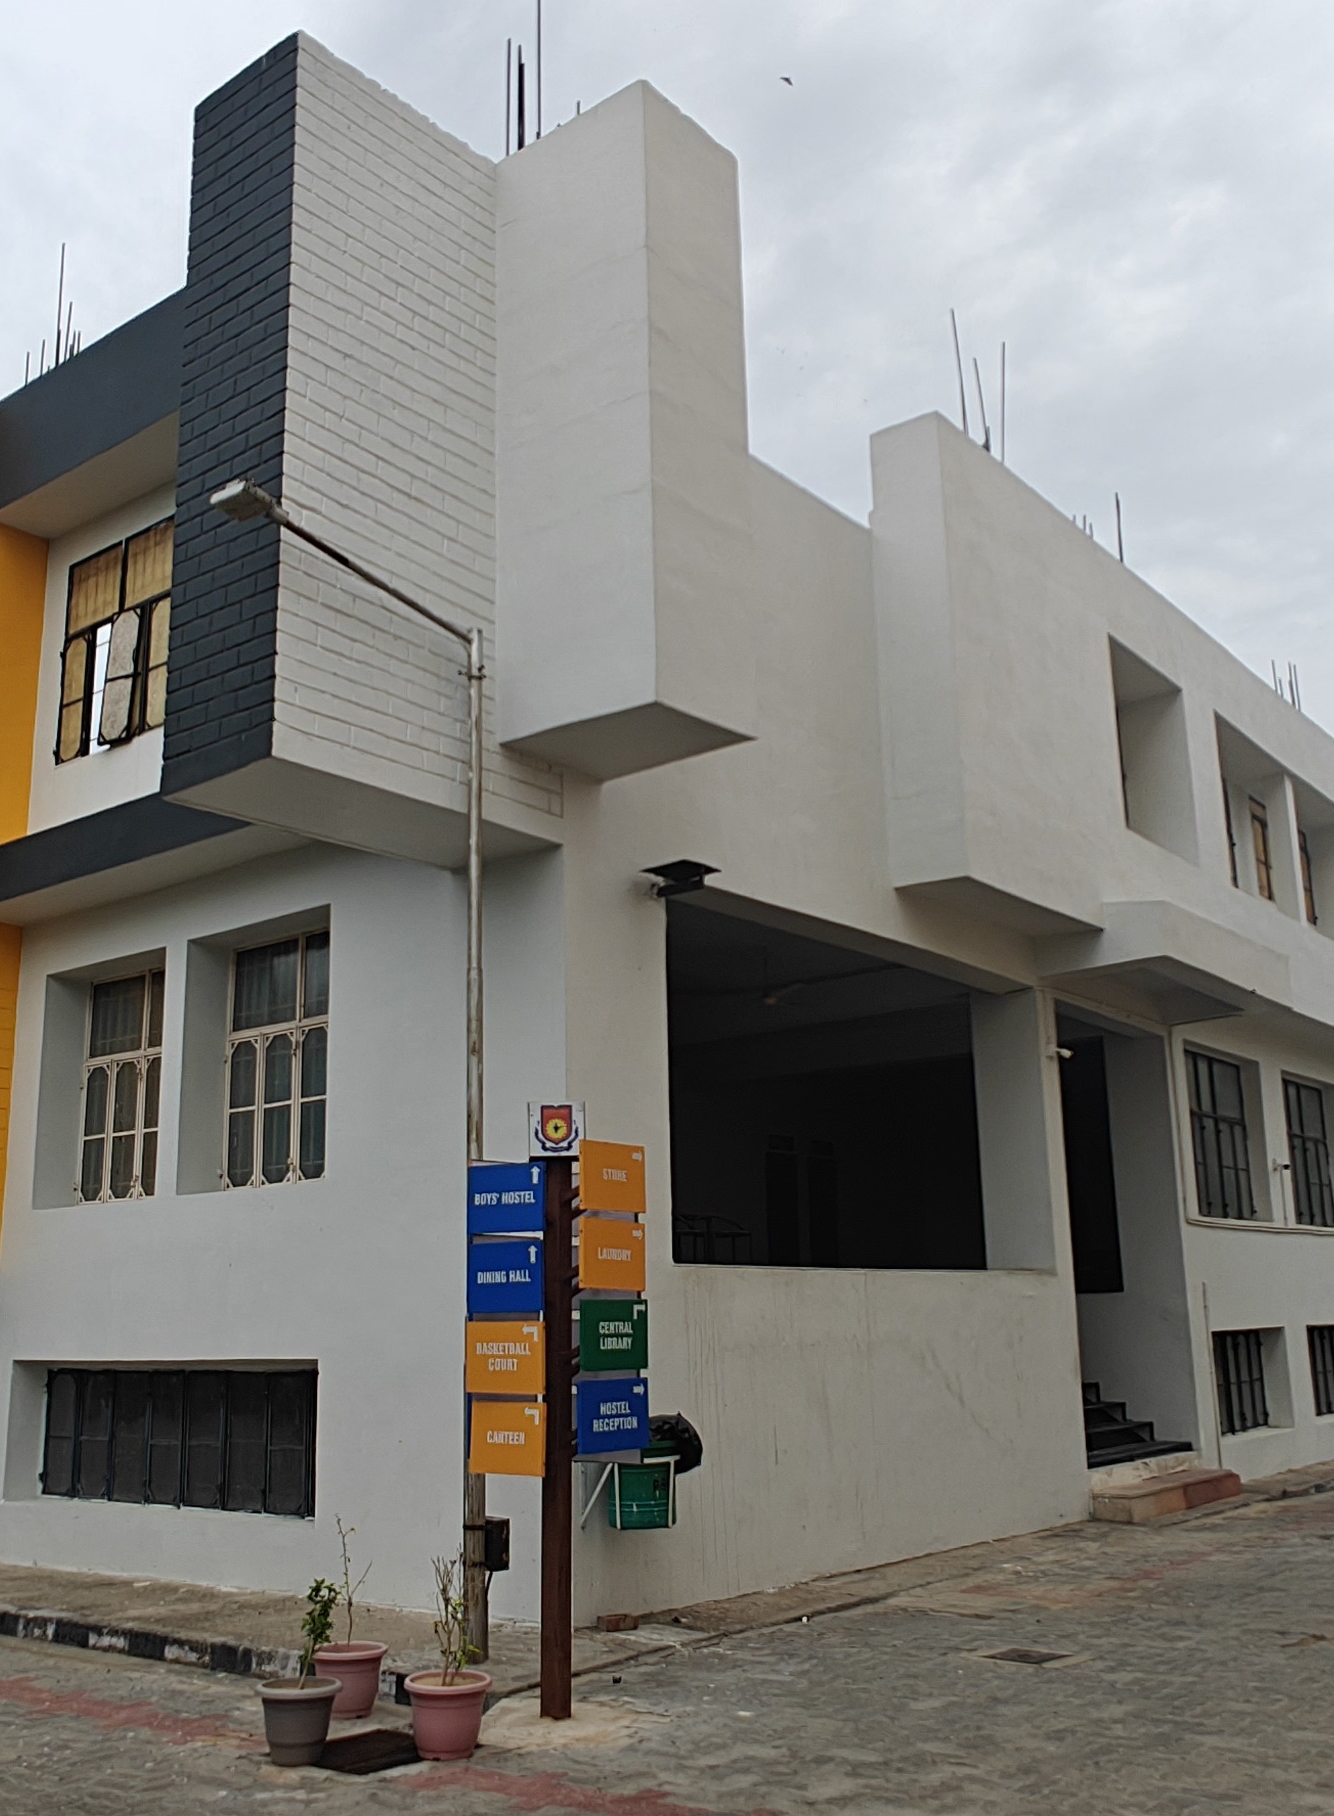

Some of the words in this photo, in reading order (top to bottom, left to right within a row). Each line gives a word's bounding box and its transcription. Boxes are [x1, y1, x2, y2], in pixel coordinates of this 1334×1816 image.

[603, 1168, 627, 1182] STORE
[501, 1190, 536, 1204] HOSTEL
[598, 1247, 632, 1261] LAUNDRY
[477, 1270, 507, 1284] DINING
[509, 1269, 531, 1282] HALL
[599, 1321, 634, 1334] CENTRAL
[476, 1342, 531, 1355] BASKETBALL
[600, 1337, 633, 1350] LIBRARY
[488, 1358, 518, 1371] COURT
[600, 1401, 631, 1415] HOSTEL
[593, 1416, 638, 1432] RECEPTION
[487, 1430, 525, 1445] CANTEEN
